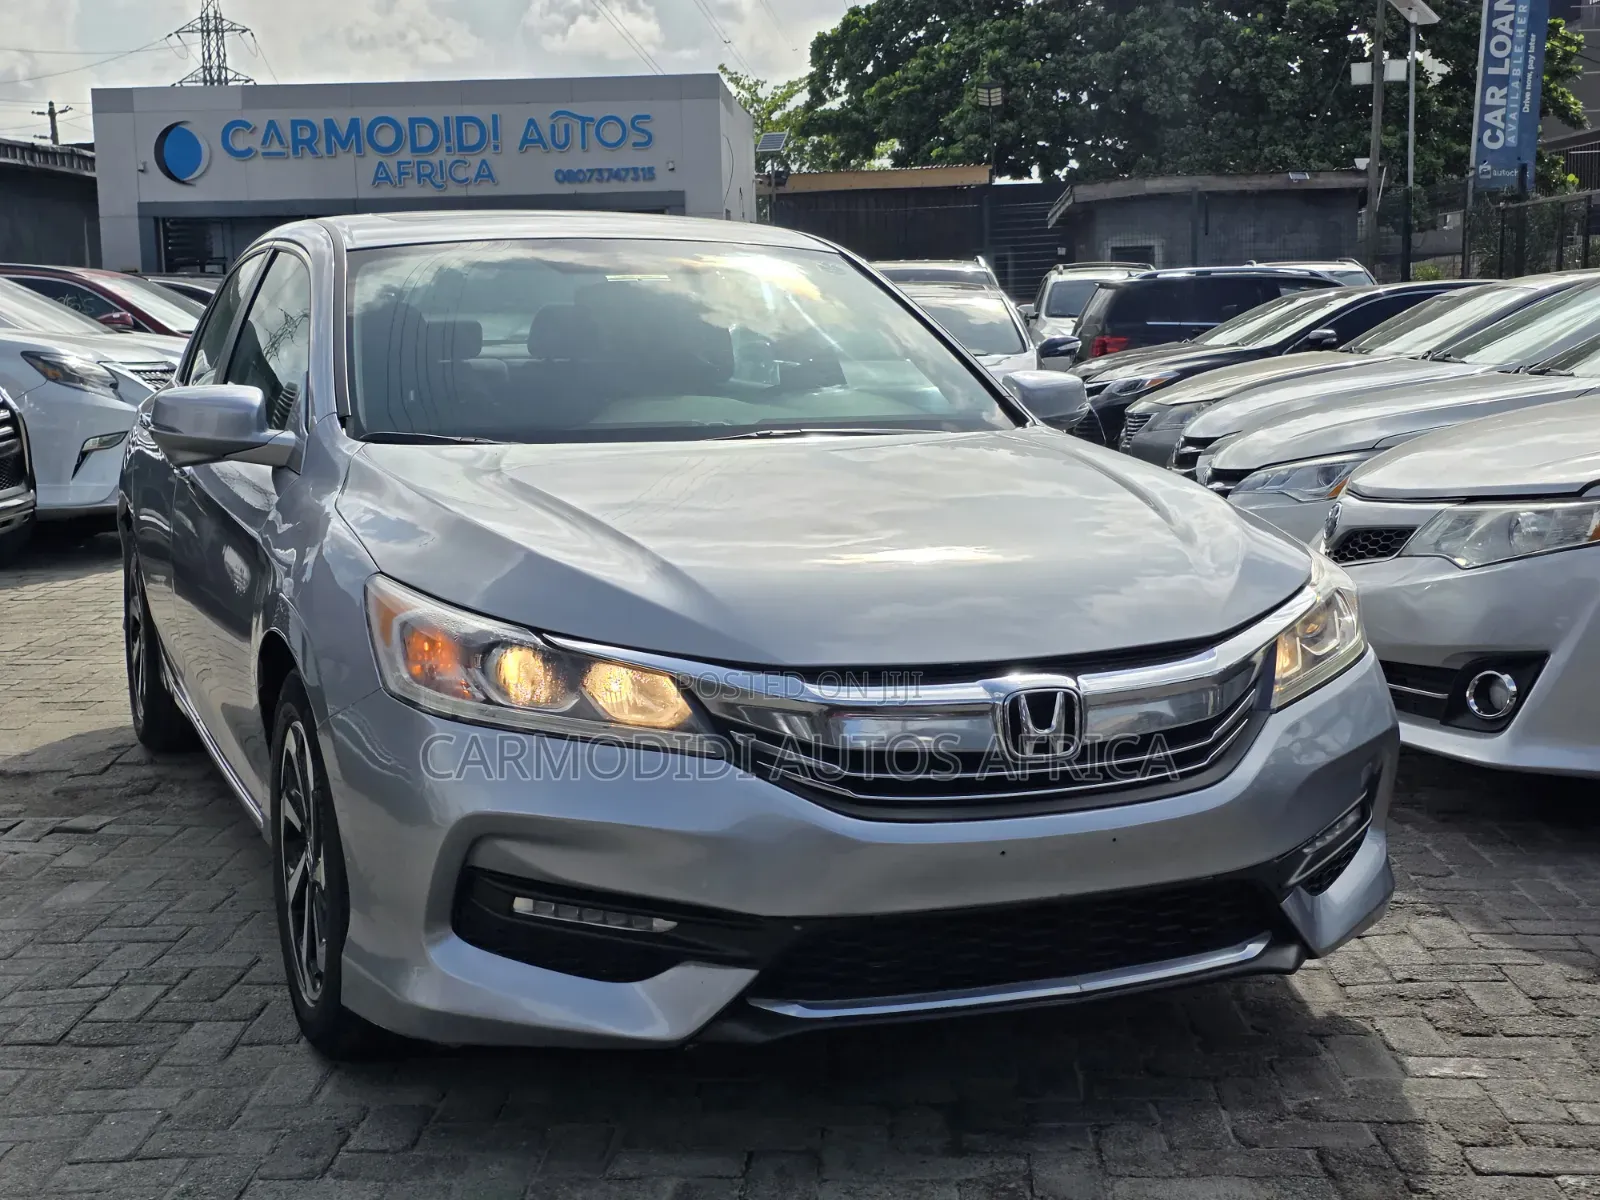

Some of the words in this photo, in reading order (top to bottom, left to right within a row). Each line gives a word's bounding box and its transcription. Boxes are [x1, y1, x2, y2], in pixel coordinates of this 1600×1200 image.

[1528, 32, 1536, 53] later
[1528, 54, 1536, 70] pay
[1526, 70, 1534, 90] now,
[1507, 45, 1524, 144] AVAILABLE
[1522, 91, 1531, 113] Drive
[518, 109, 654, 153] AUTOS
[1482, 86, 1508, 149] CAR
[371, 158, 498, 191] AFRICA
